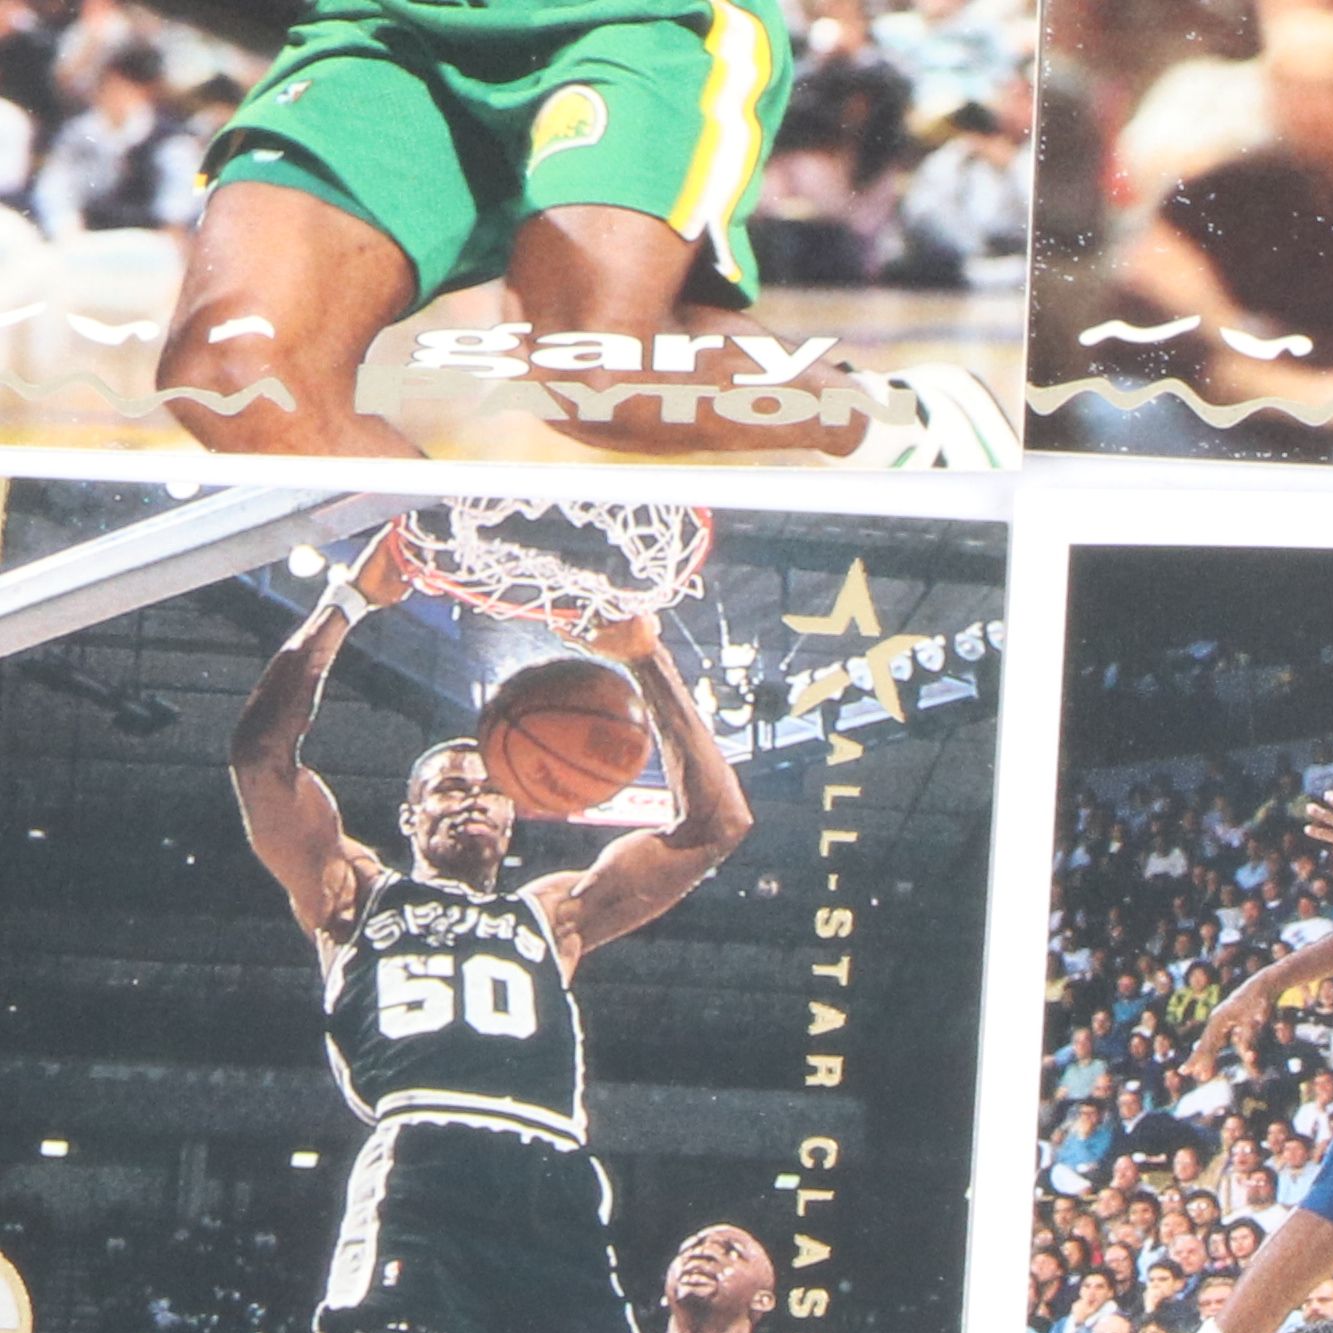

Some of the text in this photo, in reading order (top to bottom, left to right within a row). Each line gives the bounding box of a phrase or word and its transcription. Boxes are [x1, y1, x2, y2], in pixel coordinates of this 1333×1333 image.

[407, 322, 840, 386] gary
[804, 732, 865, 1087] ALL-STAR
[375, 954, 538, 1040] 50
